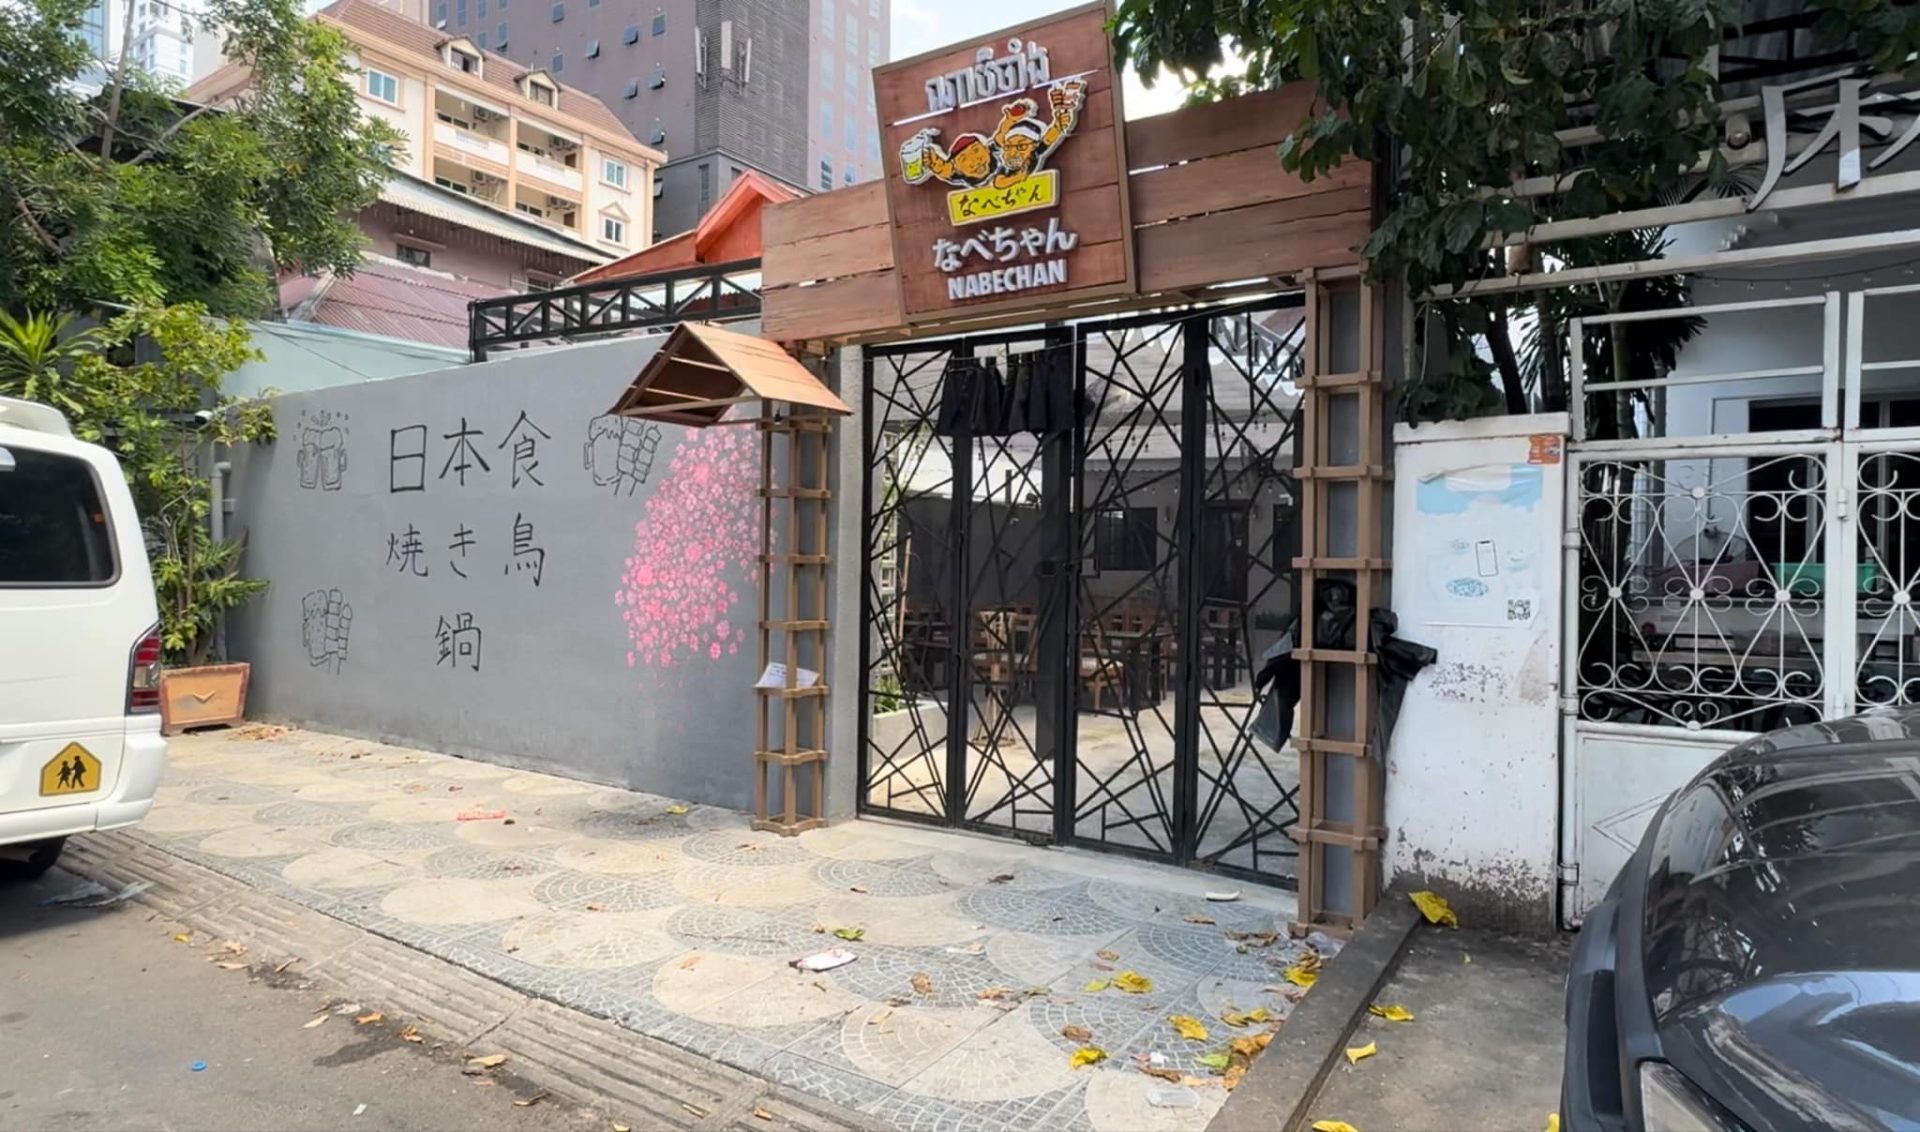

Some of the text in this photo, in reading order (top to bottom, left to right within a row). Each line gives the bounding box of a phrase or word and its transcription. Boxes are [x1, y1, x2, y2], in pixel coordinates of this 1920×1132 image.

[932, 217, 1079, 273] なべちゃん
[947, 259, 1068, 301] NABECHAN
[389, 410, 552, 495] 日本食
[386, 512, 546, 588] 焼き鳥
[434, 611, 482, 673] 鍋
